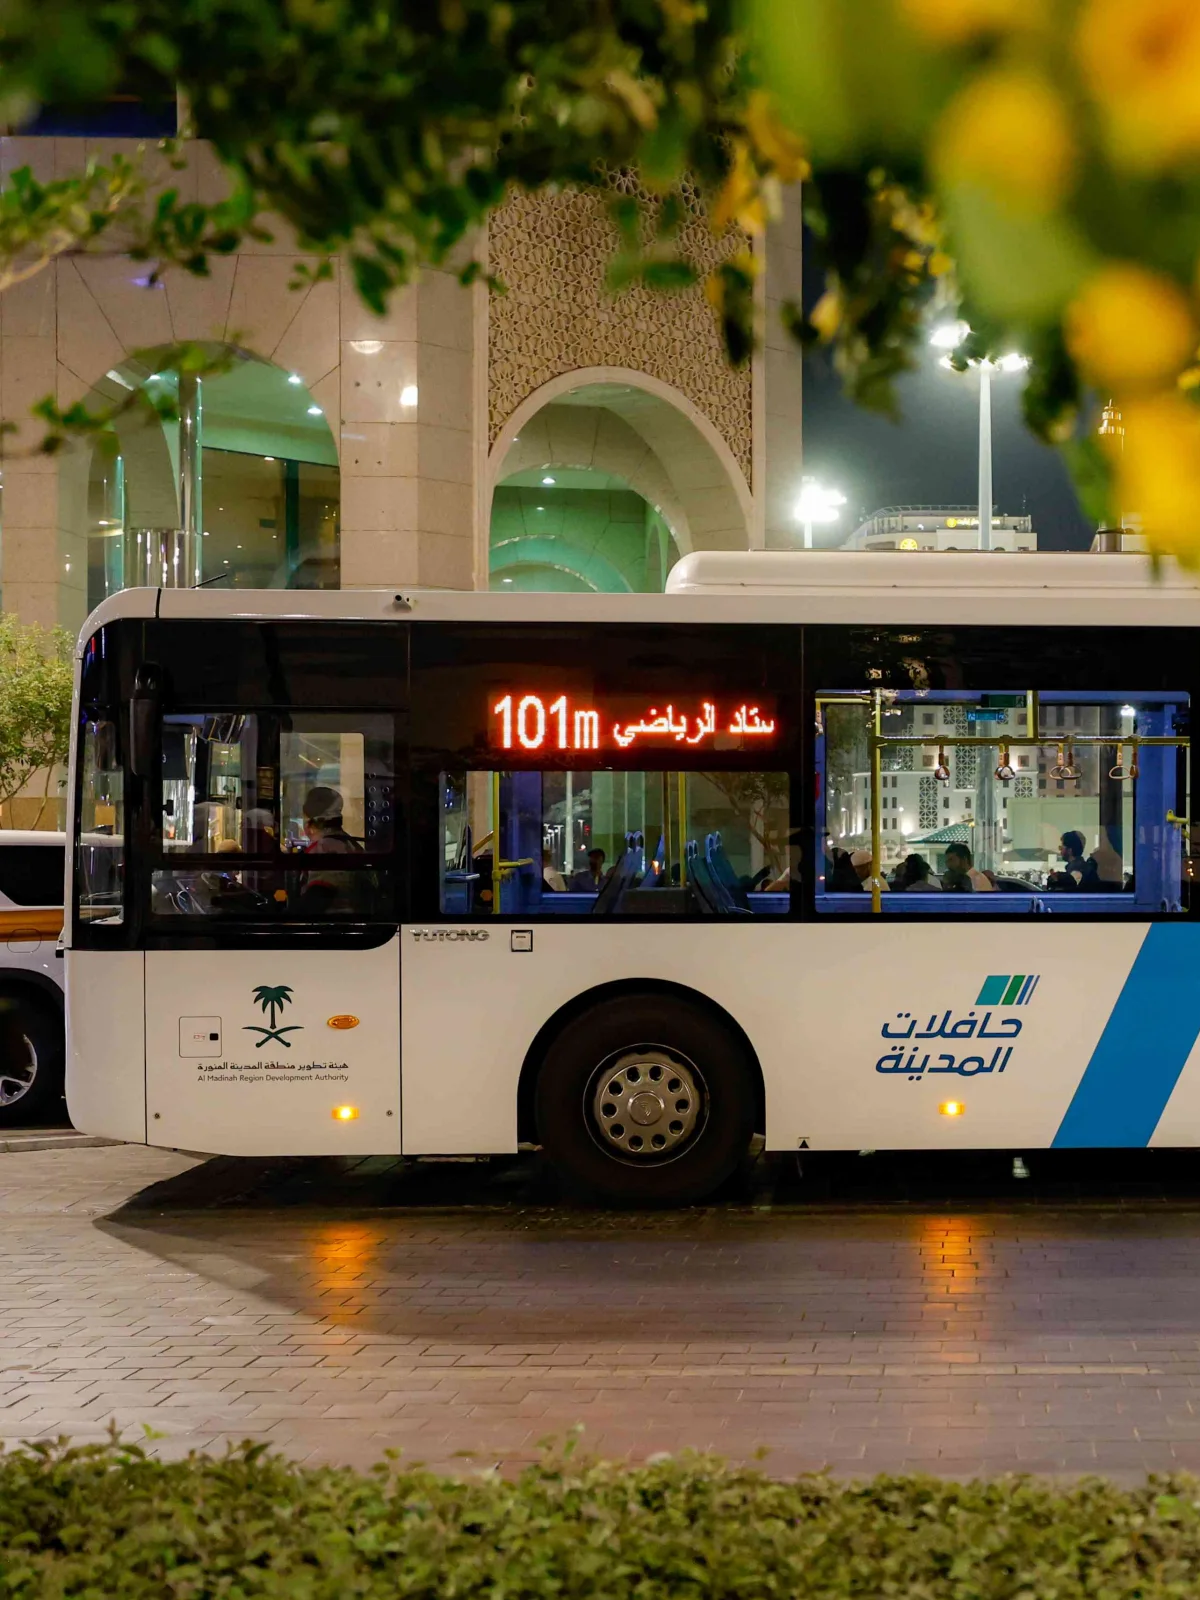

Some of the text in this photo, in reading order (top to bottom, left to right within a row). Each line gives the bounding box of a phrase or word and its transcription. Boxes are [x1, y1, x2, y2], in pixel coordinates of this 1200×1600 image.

[494, 695, 599, 749] 101m
[613, 702, 774, 747] ستاد الرياضي
[409, 929, 490, 941] YUTONG
[881, 1010, 1023, 1039] حافلات
[197, 1061, 349, 1071] هيئة تطوير منطقة المدينة المنورة
[875, 1046, 1014, 1081] المدينة
[207, 1074, 238, 1082] Madinah
[239, 1074, 264, 1083] Region
[266, 1074, 313, 1083] Development
[315, 1074, 349, 1082] Authority
